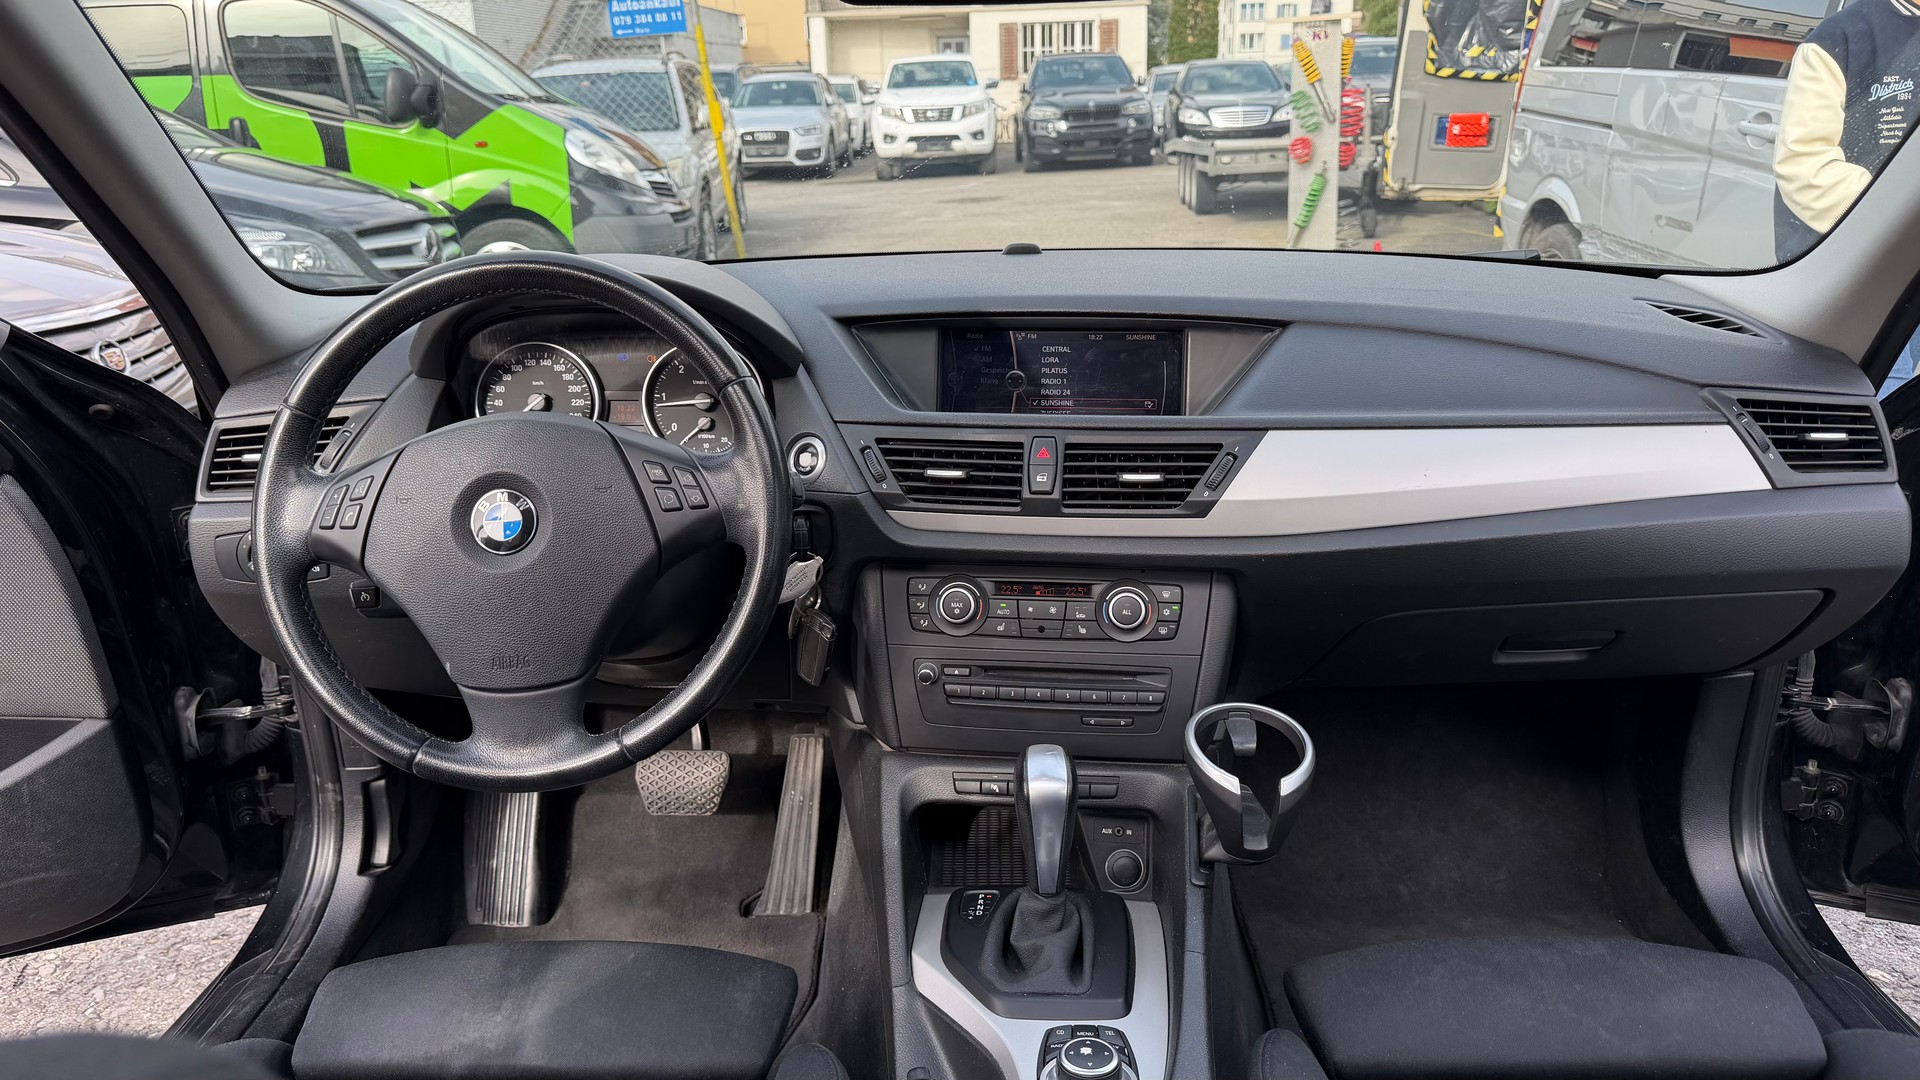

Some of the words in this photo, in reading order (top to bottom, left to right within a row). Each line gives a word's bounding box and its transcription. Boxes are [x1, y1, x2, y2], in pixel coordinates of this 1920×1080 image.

[613, 15, 632, 25] 079
[671, 11, 682, 21] 11
[1883, 75, 1900, 83] EAST
[679, 365, 685, 374] 2
[671, 422, 678, 431] 0
[477, 490, 530, 513] BMW
